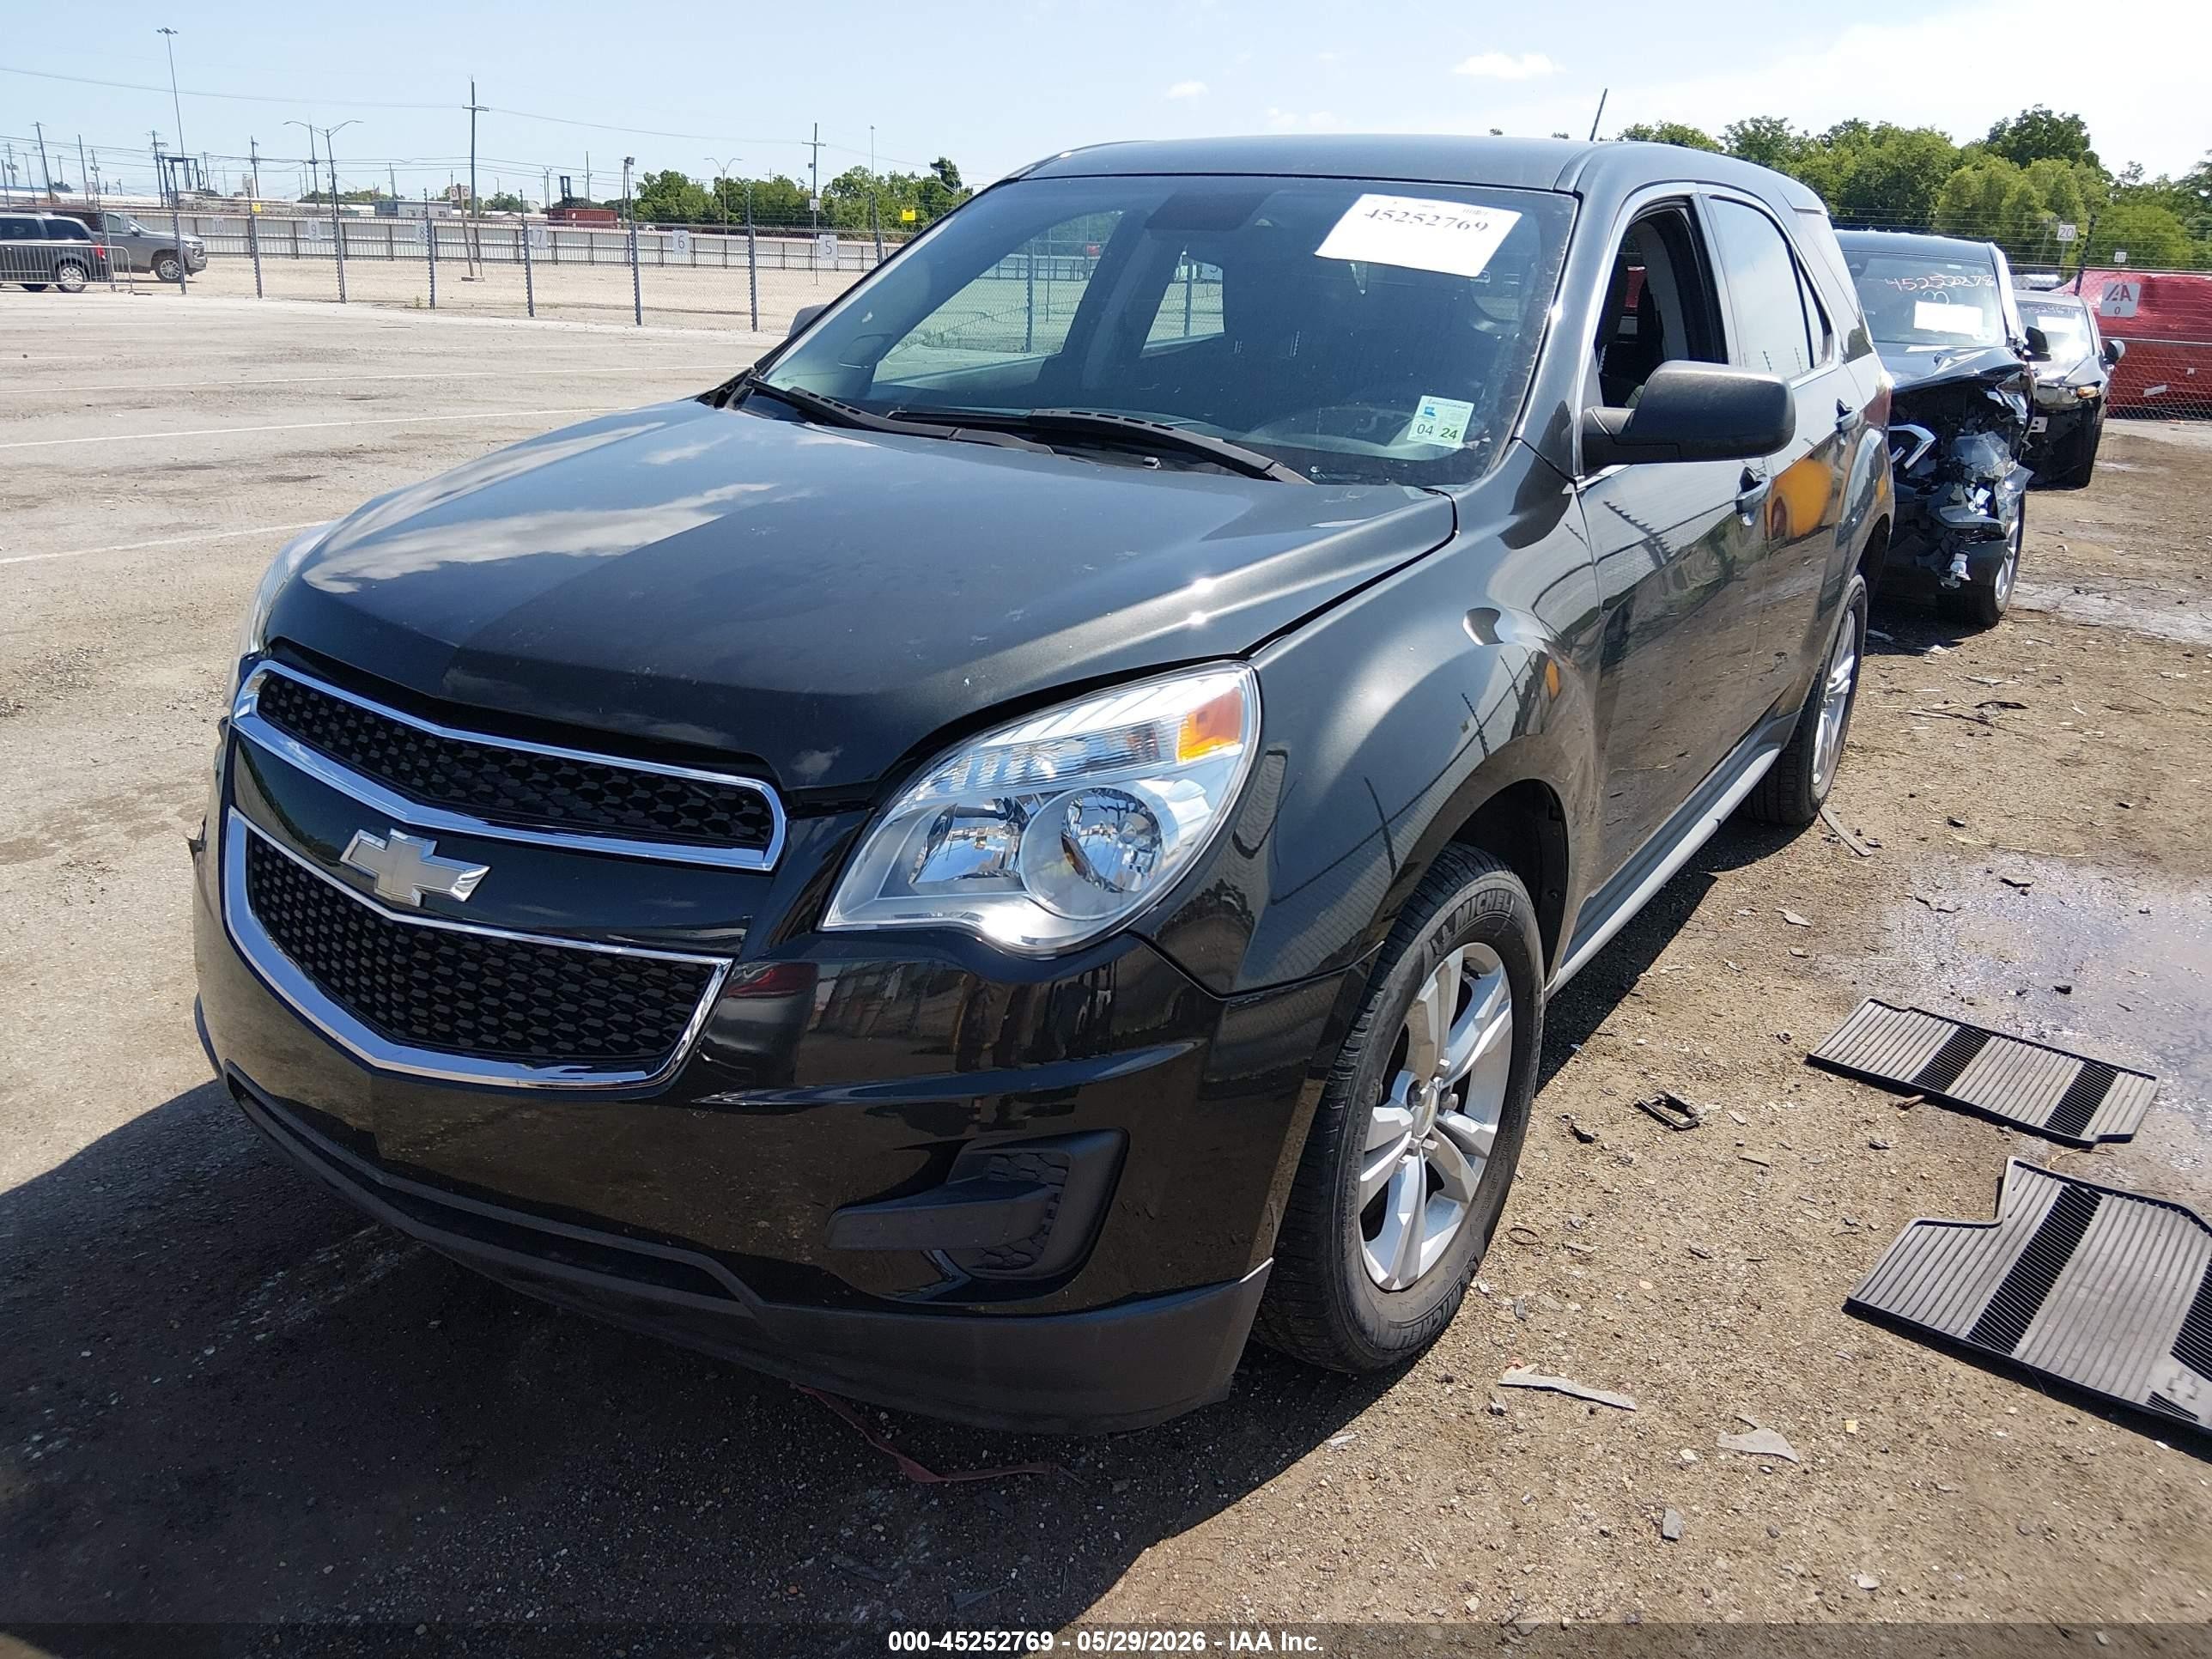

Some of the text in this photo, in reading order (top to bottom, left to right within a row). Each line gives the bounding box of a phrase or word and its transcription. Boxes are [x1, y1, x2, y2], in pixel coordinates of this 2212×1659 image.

[451, 188, 458, 198] D
[462, 188, 469, 198] C
[214, 220, 225, 233] 10
[1364, 209, 1489, 231] 45252769
[310, 224, 318, 236] 9
[419, 226, 426, 240] 8
[538, 229, 543, 243] 7
[2060, 228, 2074, 238] 20
[678, 234, 685, 249] 6
[825, 240, 833, 255] 5
[1417, 423, 1458, 441] 04 24
[1454, 890, 1516, 933] MICHEL
